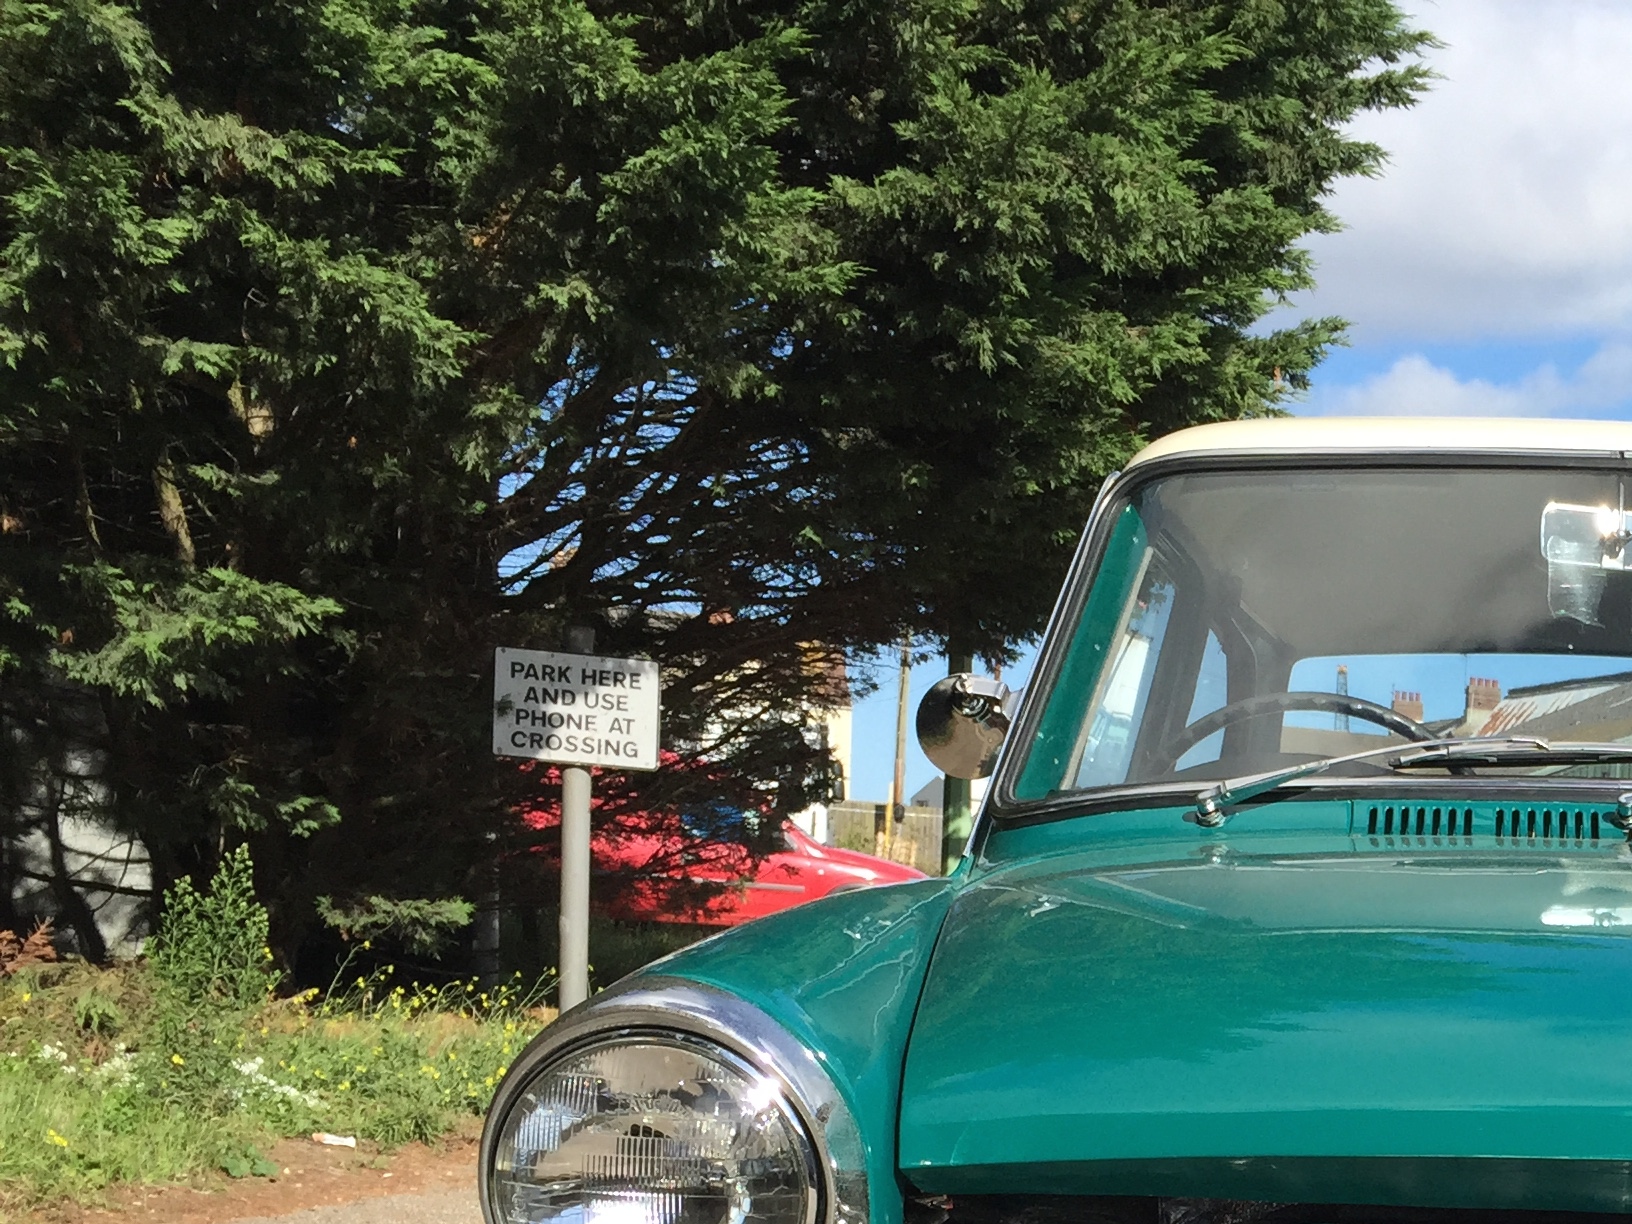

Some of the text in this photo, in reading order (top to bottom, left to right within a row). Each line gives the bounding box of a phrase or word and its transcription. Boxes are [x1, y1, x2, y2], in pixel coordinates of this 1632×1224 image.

[510, 661, 642, 690] PARK HERE
[523, 686, 629, 712] AND USE
[515, 708, 635, 735] PHONE AT
[510, 730, 638, 758] CROSSING
